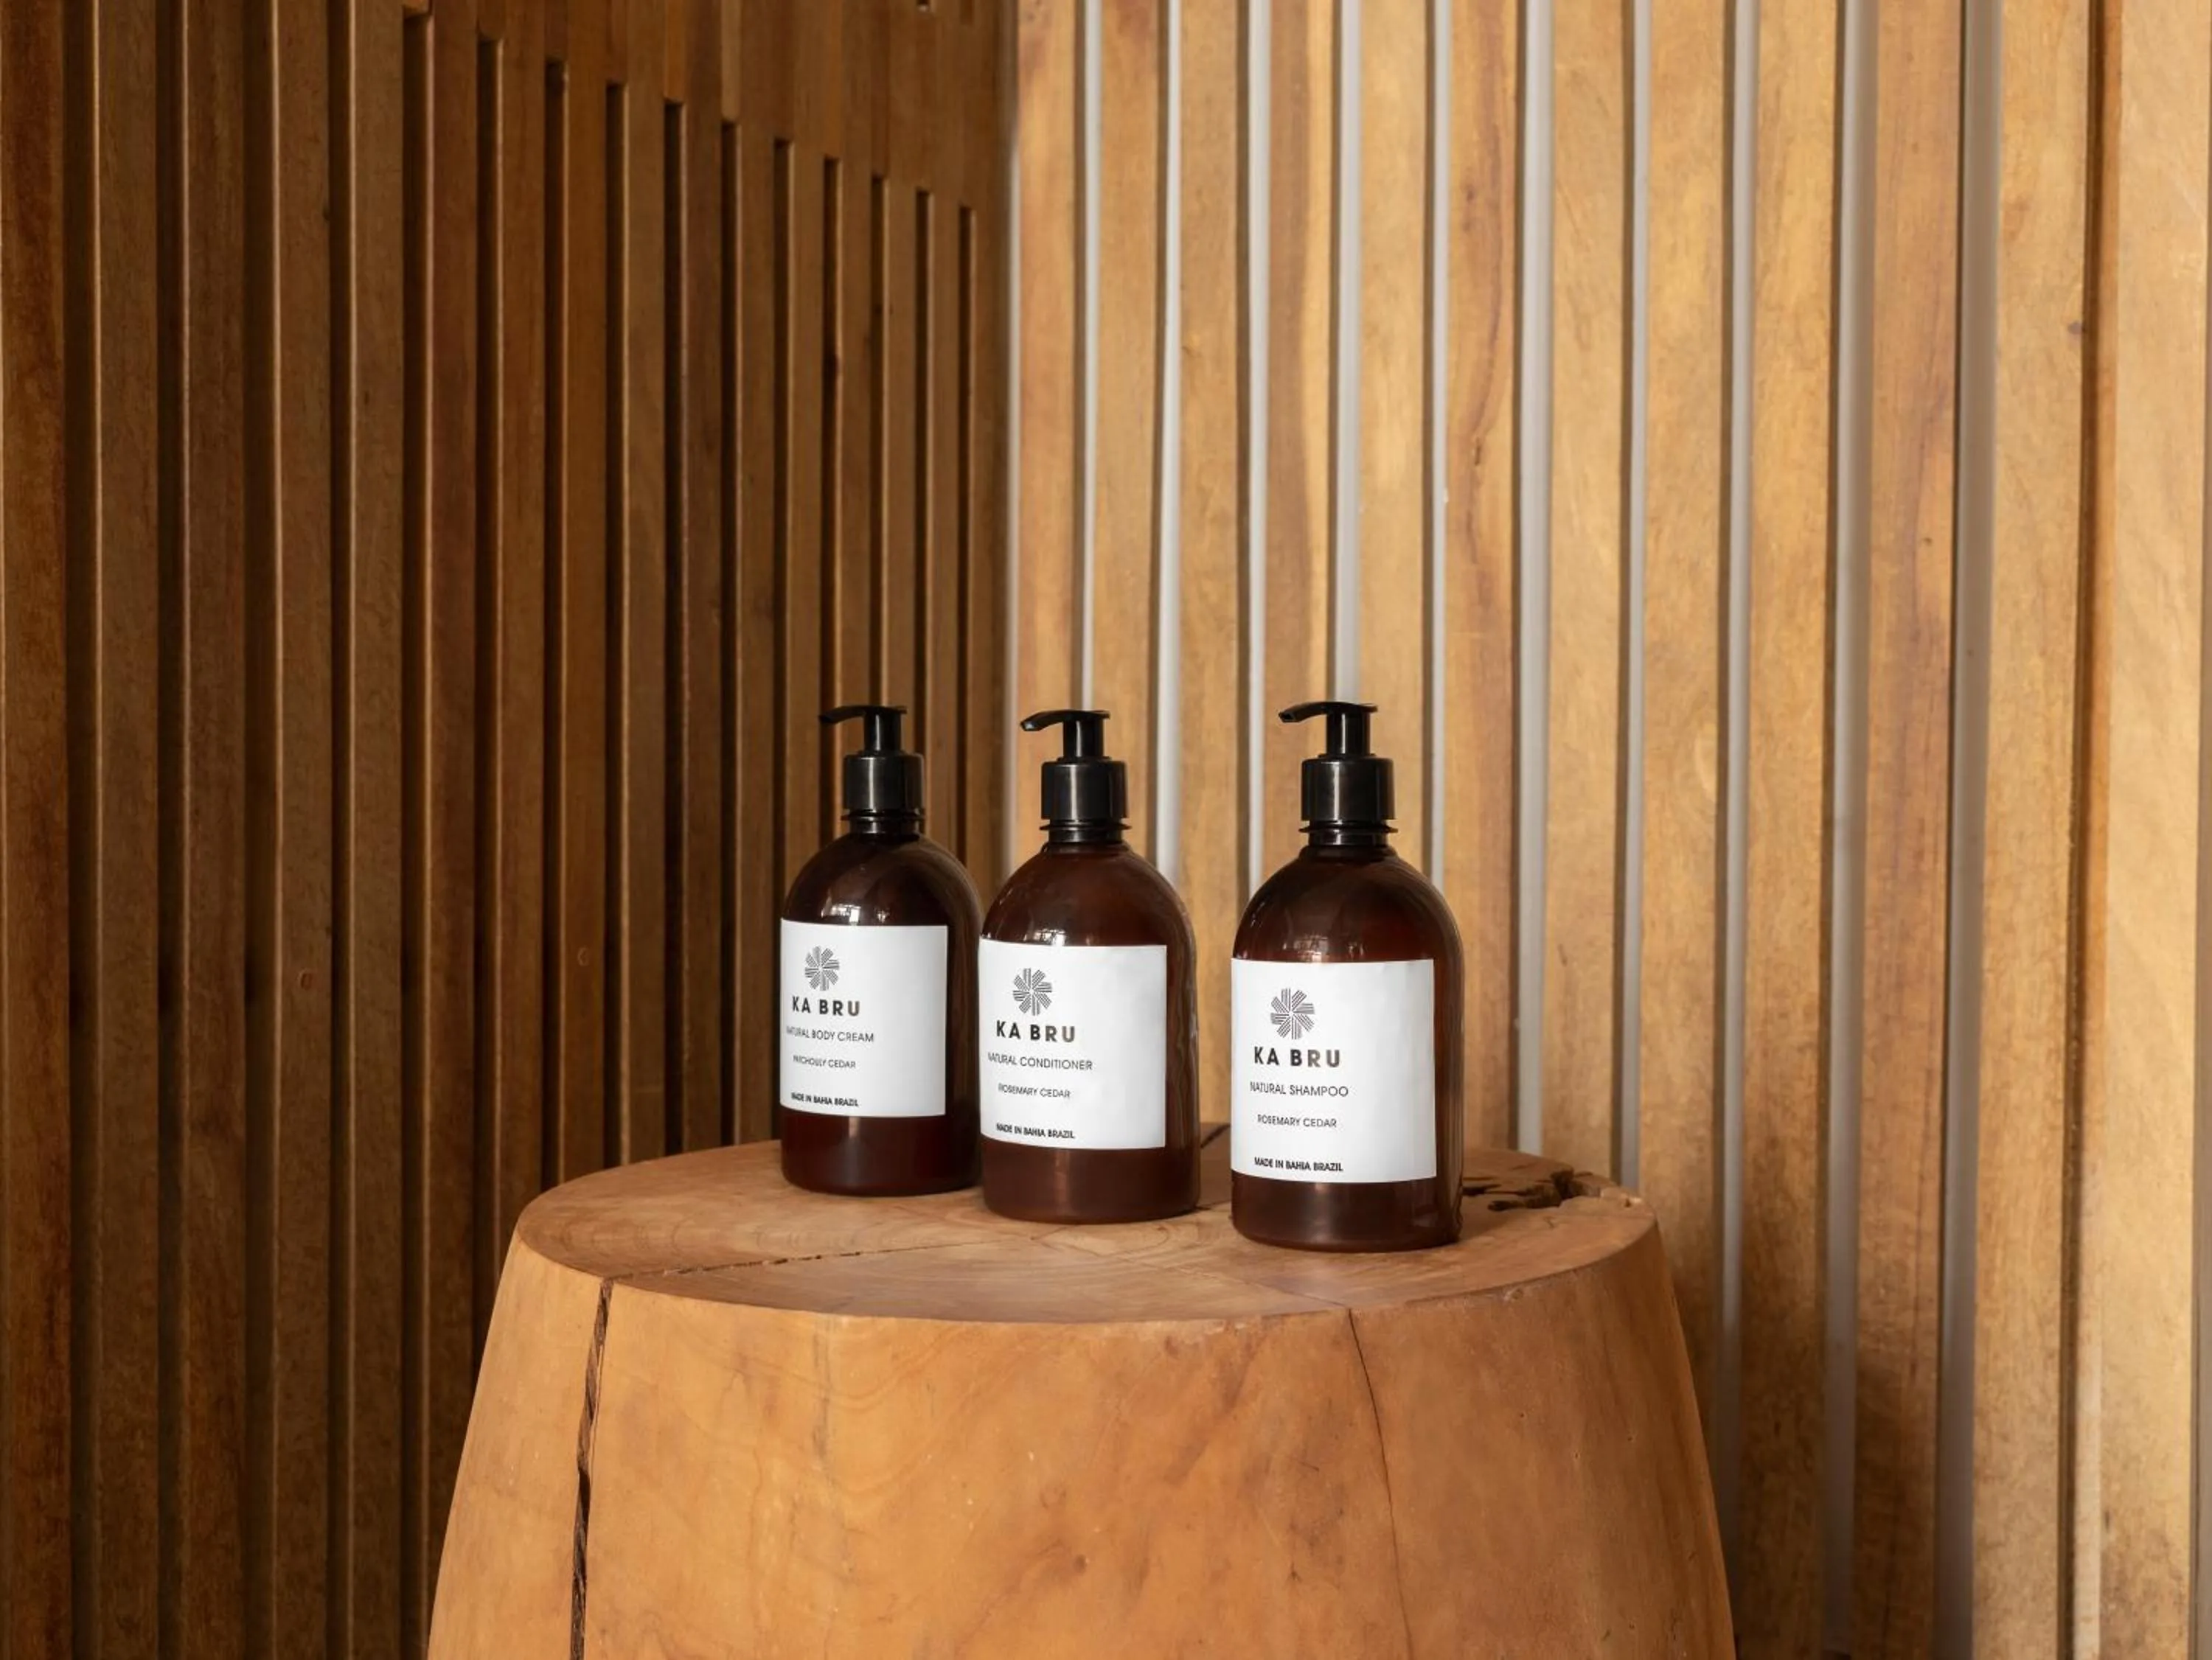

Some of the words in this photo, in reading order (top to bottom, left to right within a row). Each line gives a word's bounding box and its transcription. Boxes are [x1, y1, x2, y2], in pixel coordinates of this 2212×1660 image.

[792, 996, 810, 1013] KA
[819, 1000, 860, 1016] BRU
[813, 1029, 835, 1041] BODY
[838, 1031, 874, 1042] CREAM
[996, 1019, 1020, 1039] KA
[1030, 1025, 1075, 1042] BRU
[828, 1059, 856, 1068] CEDAR
[988, 1052, 1017, 1065] NATURAL
[1020, 1056, 1093, 1070] CONDITIONER
[1254, 1046, 1279, 1066] KA
[1290, 1049, 1340, 1067] BRU
[998, 1083, 1038, 1096] ROSEMARY
[1040, 1087, 1071, 1098] CEDAR
[1251, 1081, 1286, 1095] NATURAL
[1290, 1085, 1349, 1097] SHAMPOO
[805, 1095, 811, 1103] IN
[813, 1095, 832, 1105] BAHIA
[835, 1098, 859, 1106] BRAZIL
[1258, 1114, 1300, 1126] ROSEMARY
[1304, 1117, 1336, 1128] CEDAR
[996, 1123, 1012, 1133] MADE
[1015, 1125, 1022, 1134] IN
[1023, 1126, 1045, 1137] BAHIA
[1048, 1129, 1075, 1139] BRAZIL
[1254, 1157, 1273, 1168] MADE
[1276, 1160, 1283, 1168] IN
[1286, 1160, 1311, 1171] BAHIA
[1313, 1162, 1343, 1172] BRAZIL
